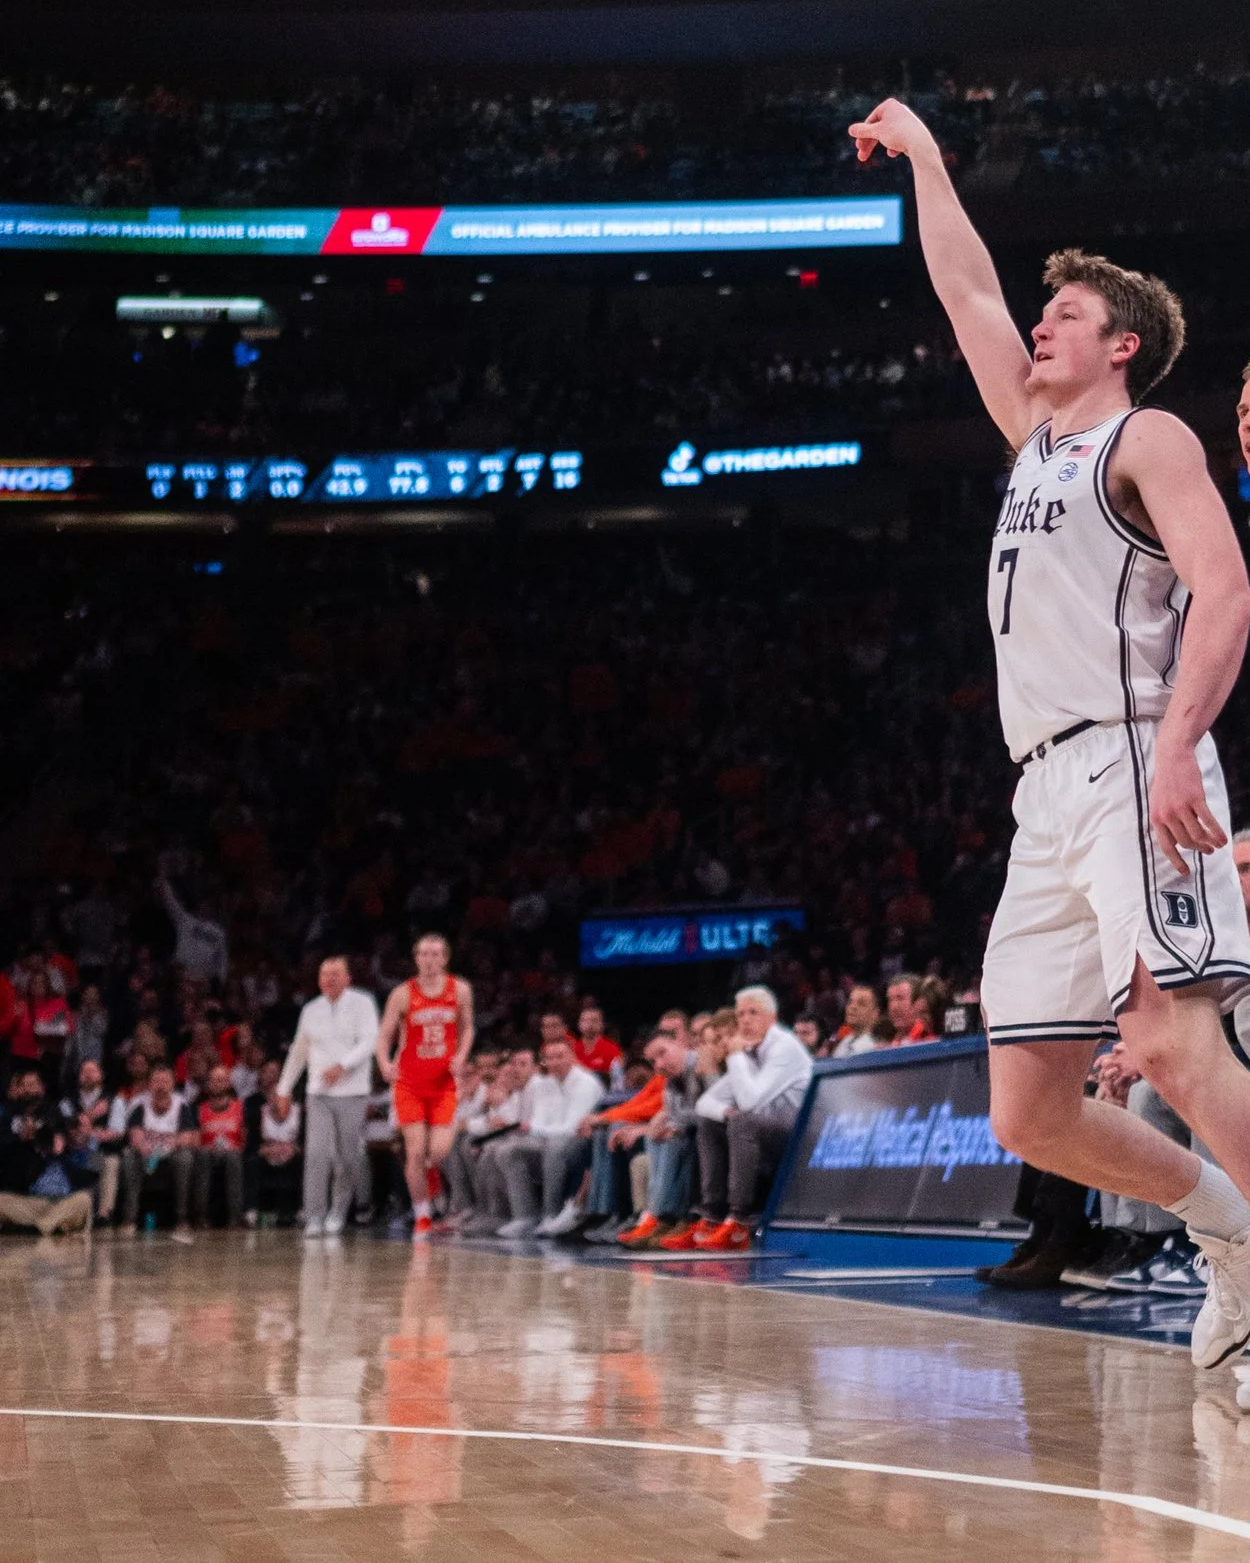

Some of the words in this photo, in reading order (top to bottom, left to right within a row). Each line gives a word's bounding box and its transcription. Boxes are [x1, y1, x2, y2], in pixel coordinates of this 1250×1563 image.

[16, 220, 87, 236] PROVIDER
[90, 222, 119, 237] FOR
[121, 223, 186, 239] MADISON
[189, 224, 244, 239] SQUARE
[247, 224, 307, 239] GARDEN
[451, 223, 513, 239] OFFICIAL
[516, 222, 601, 239] AMBULANCE
[603, 221, 670, 238] PROVIDER
[672, 220, 702, 236] FOR
[704, 218, 767, 236] MADISON
[769, 216, 824, 234] SQUARE
[826, 215, 885, 232] GARDEN
[703, 441, 861, 476] @THEGARDEN
[997, 547, 1020, 635] 7
